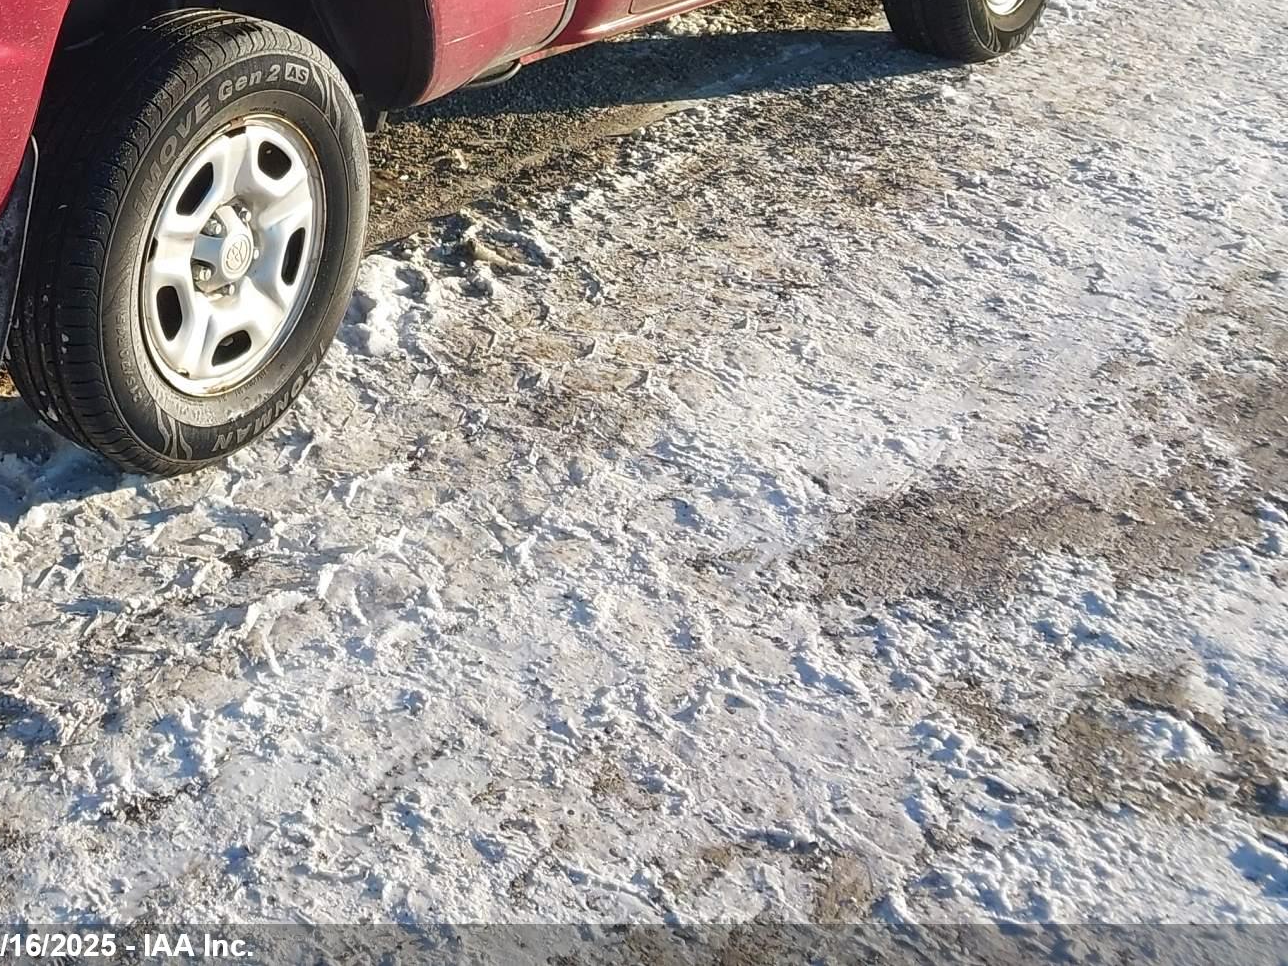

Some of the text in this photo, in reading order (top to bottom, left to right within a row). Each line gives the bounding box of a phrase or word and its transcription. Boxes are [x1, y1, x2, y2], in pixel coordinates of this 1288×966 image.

[218, 70, 262, 101] Gen
[265, 63, 281, 83] 2
[285, 62, 309, 84] AS
